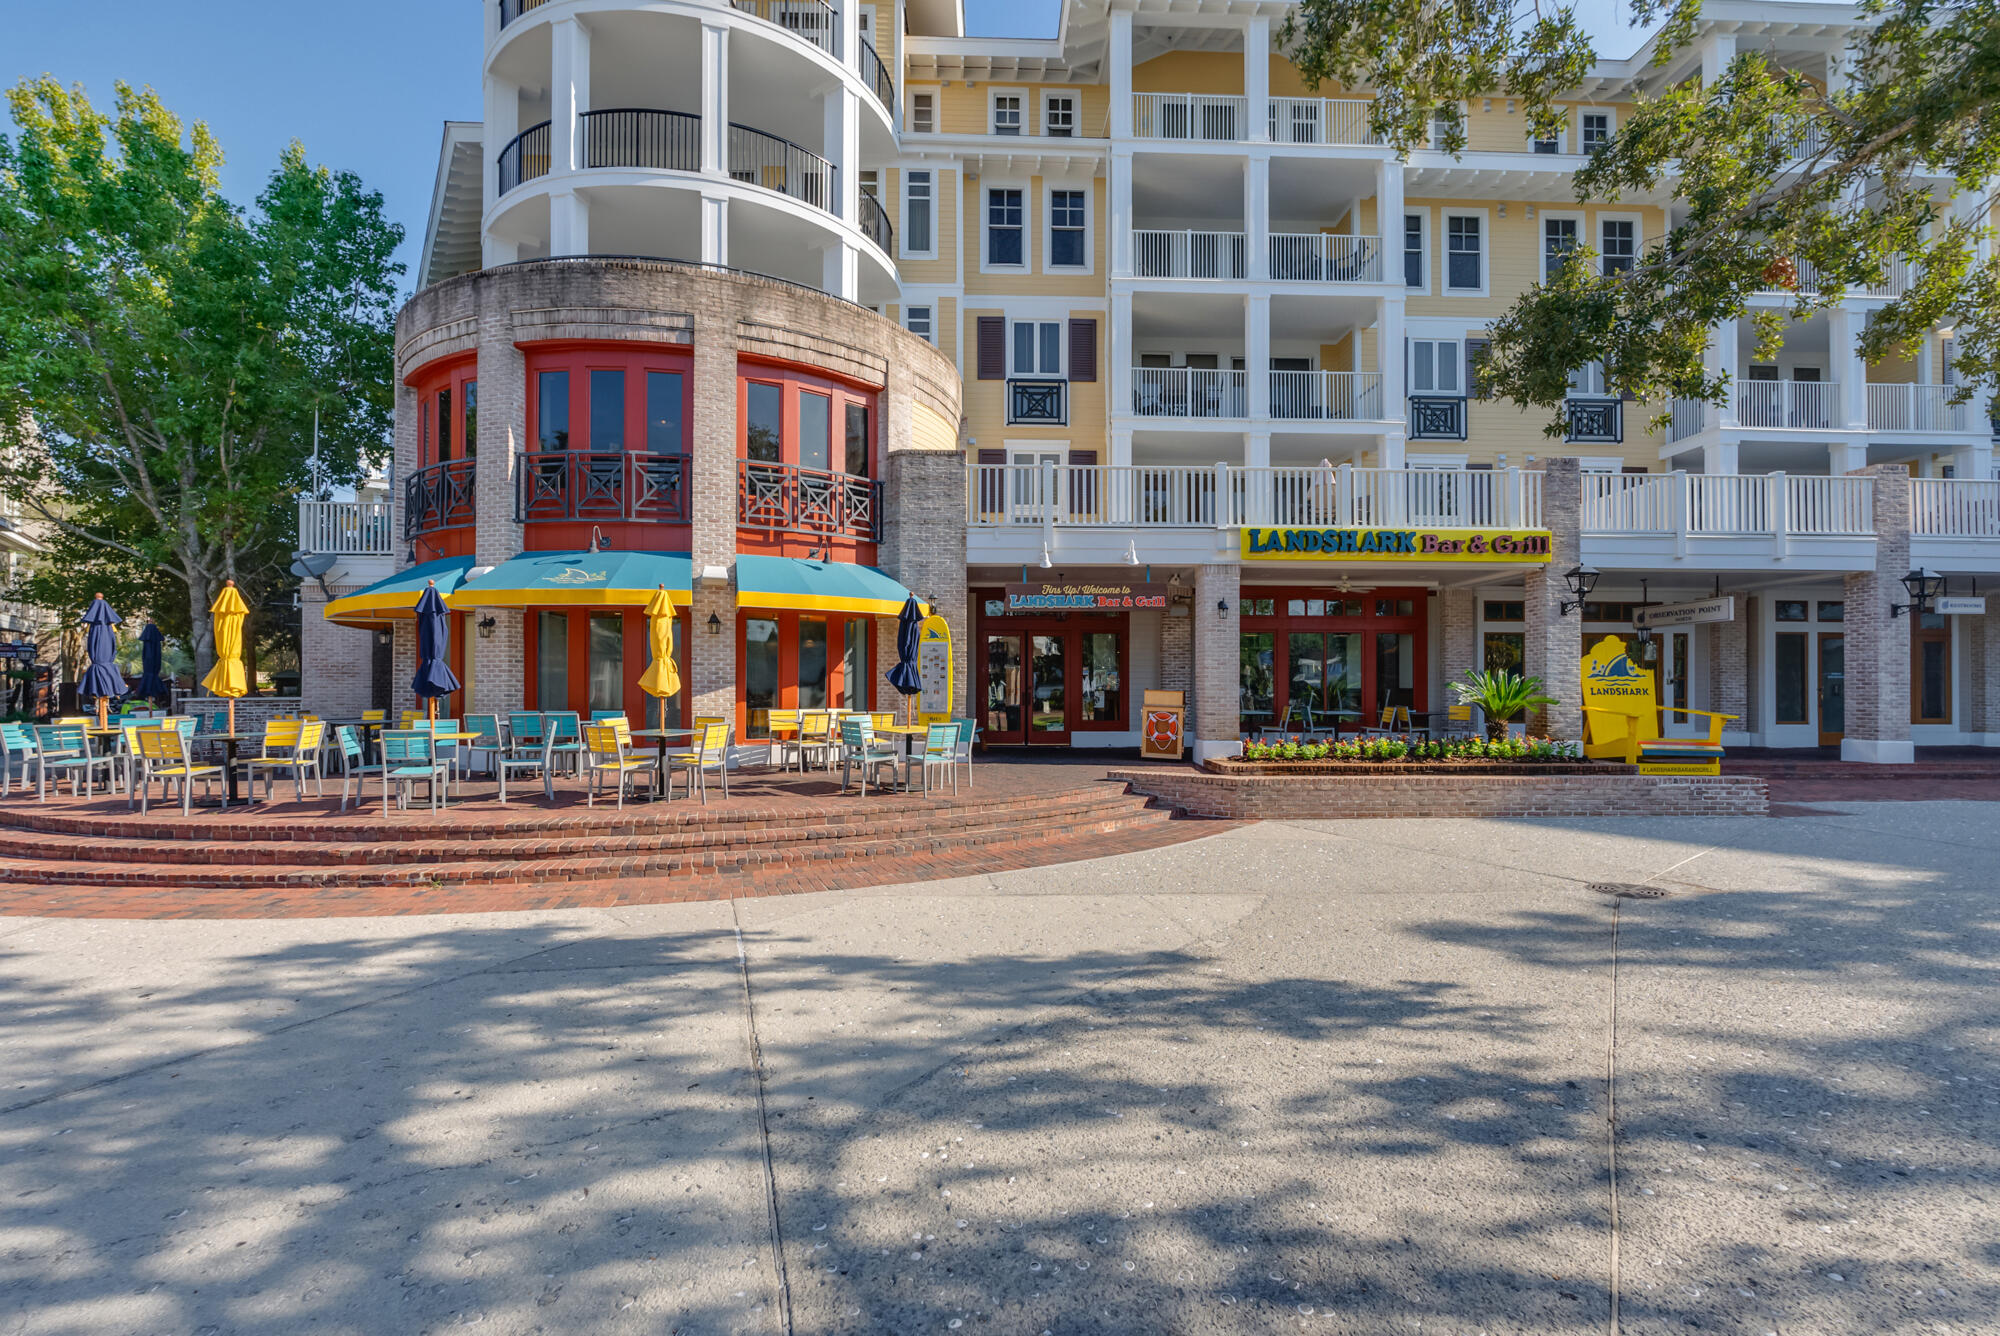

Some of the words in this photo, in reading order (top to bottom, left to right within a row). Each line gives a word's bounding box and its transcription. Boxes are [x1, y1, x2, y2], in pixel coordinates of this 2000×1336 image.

[1249, 529, 1417, 553] LANDSHARK
[1422, 534, 1466, 554] Bar
[1468, 534, 1490, 554] &
[1493, 534, 1552, 554] Grill
[1042, 584, 1062, 595] Fins
[1063, 585, 1081, 596] Up!
[1082, 584, 1121, 595] Welcome
[1121, 585, 1131, 594] to
[1010, 594, 1096, 609] LANDSHARK
[1098, 596, 1121, 607] Bar
[1122, 596, 1133, 607] &
[1135, 595, 1166, 607] Grill
[1649, 607, 1696, 619] OBSERVATION
[1698, 604, 1722, 614] POINT
[1590, 687, 1649, 696] LANDSHARK
